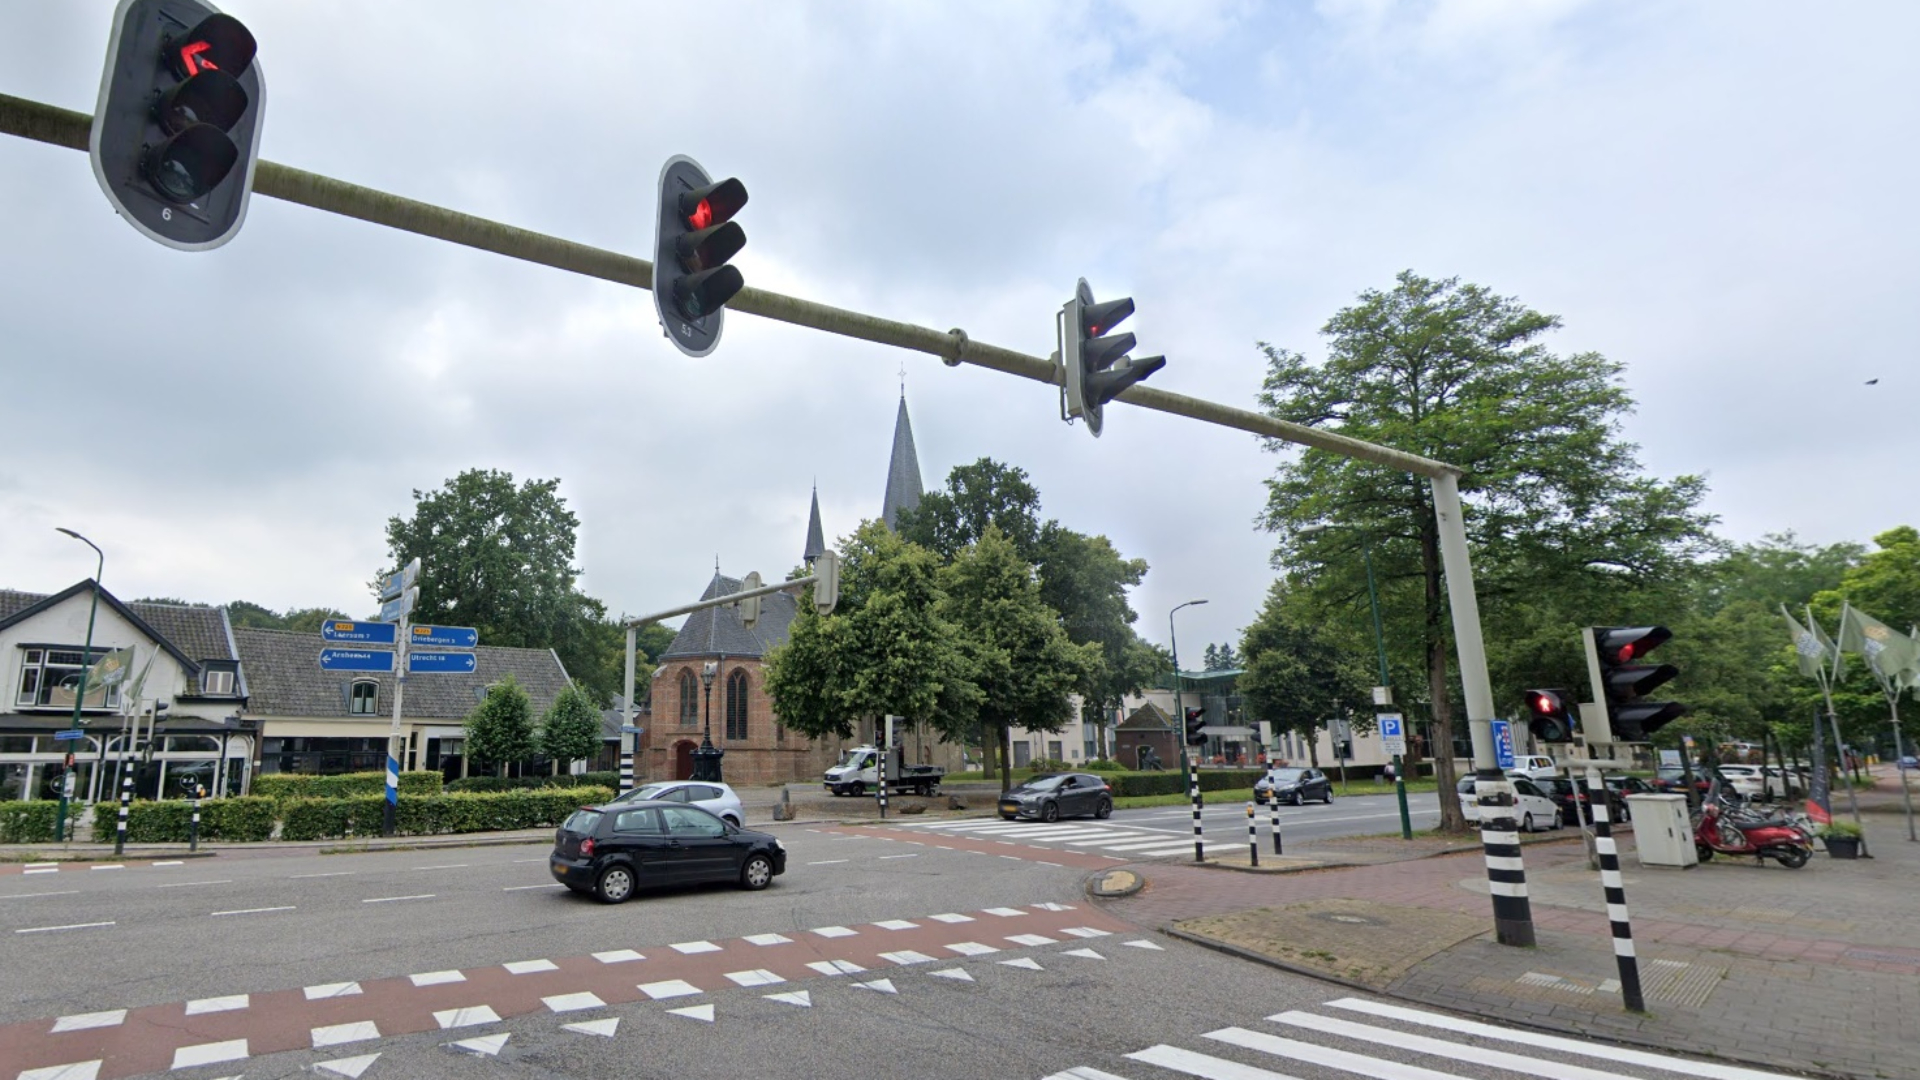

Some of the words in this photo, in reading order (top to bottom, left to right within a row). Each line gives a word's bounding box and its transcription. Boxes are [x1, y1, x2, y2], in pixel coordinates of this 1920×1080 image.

[162, 207, 172, 221] 6
[412, 635, 450, 644] Driebergen
[1385, 720, 1396, 734] P
